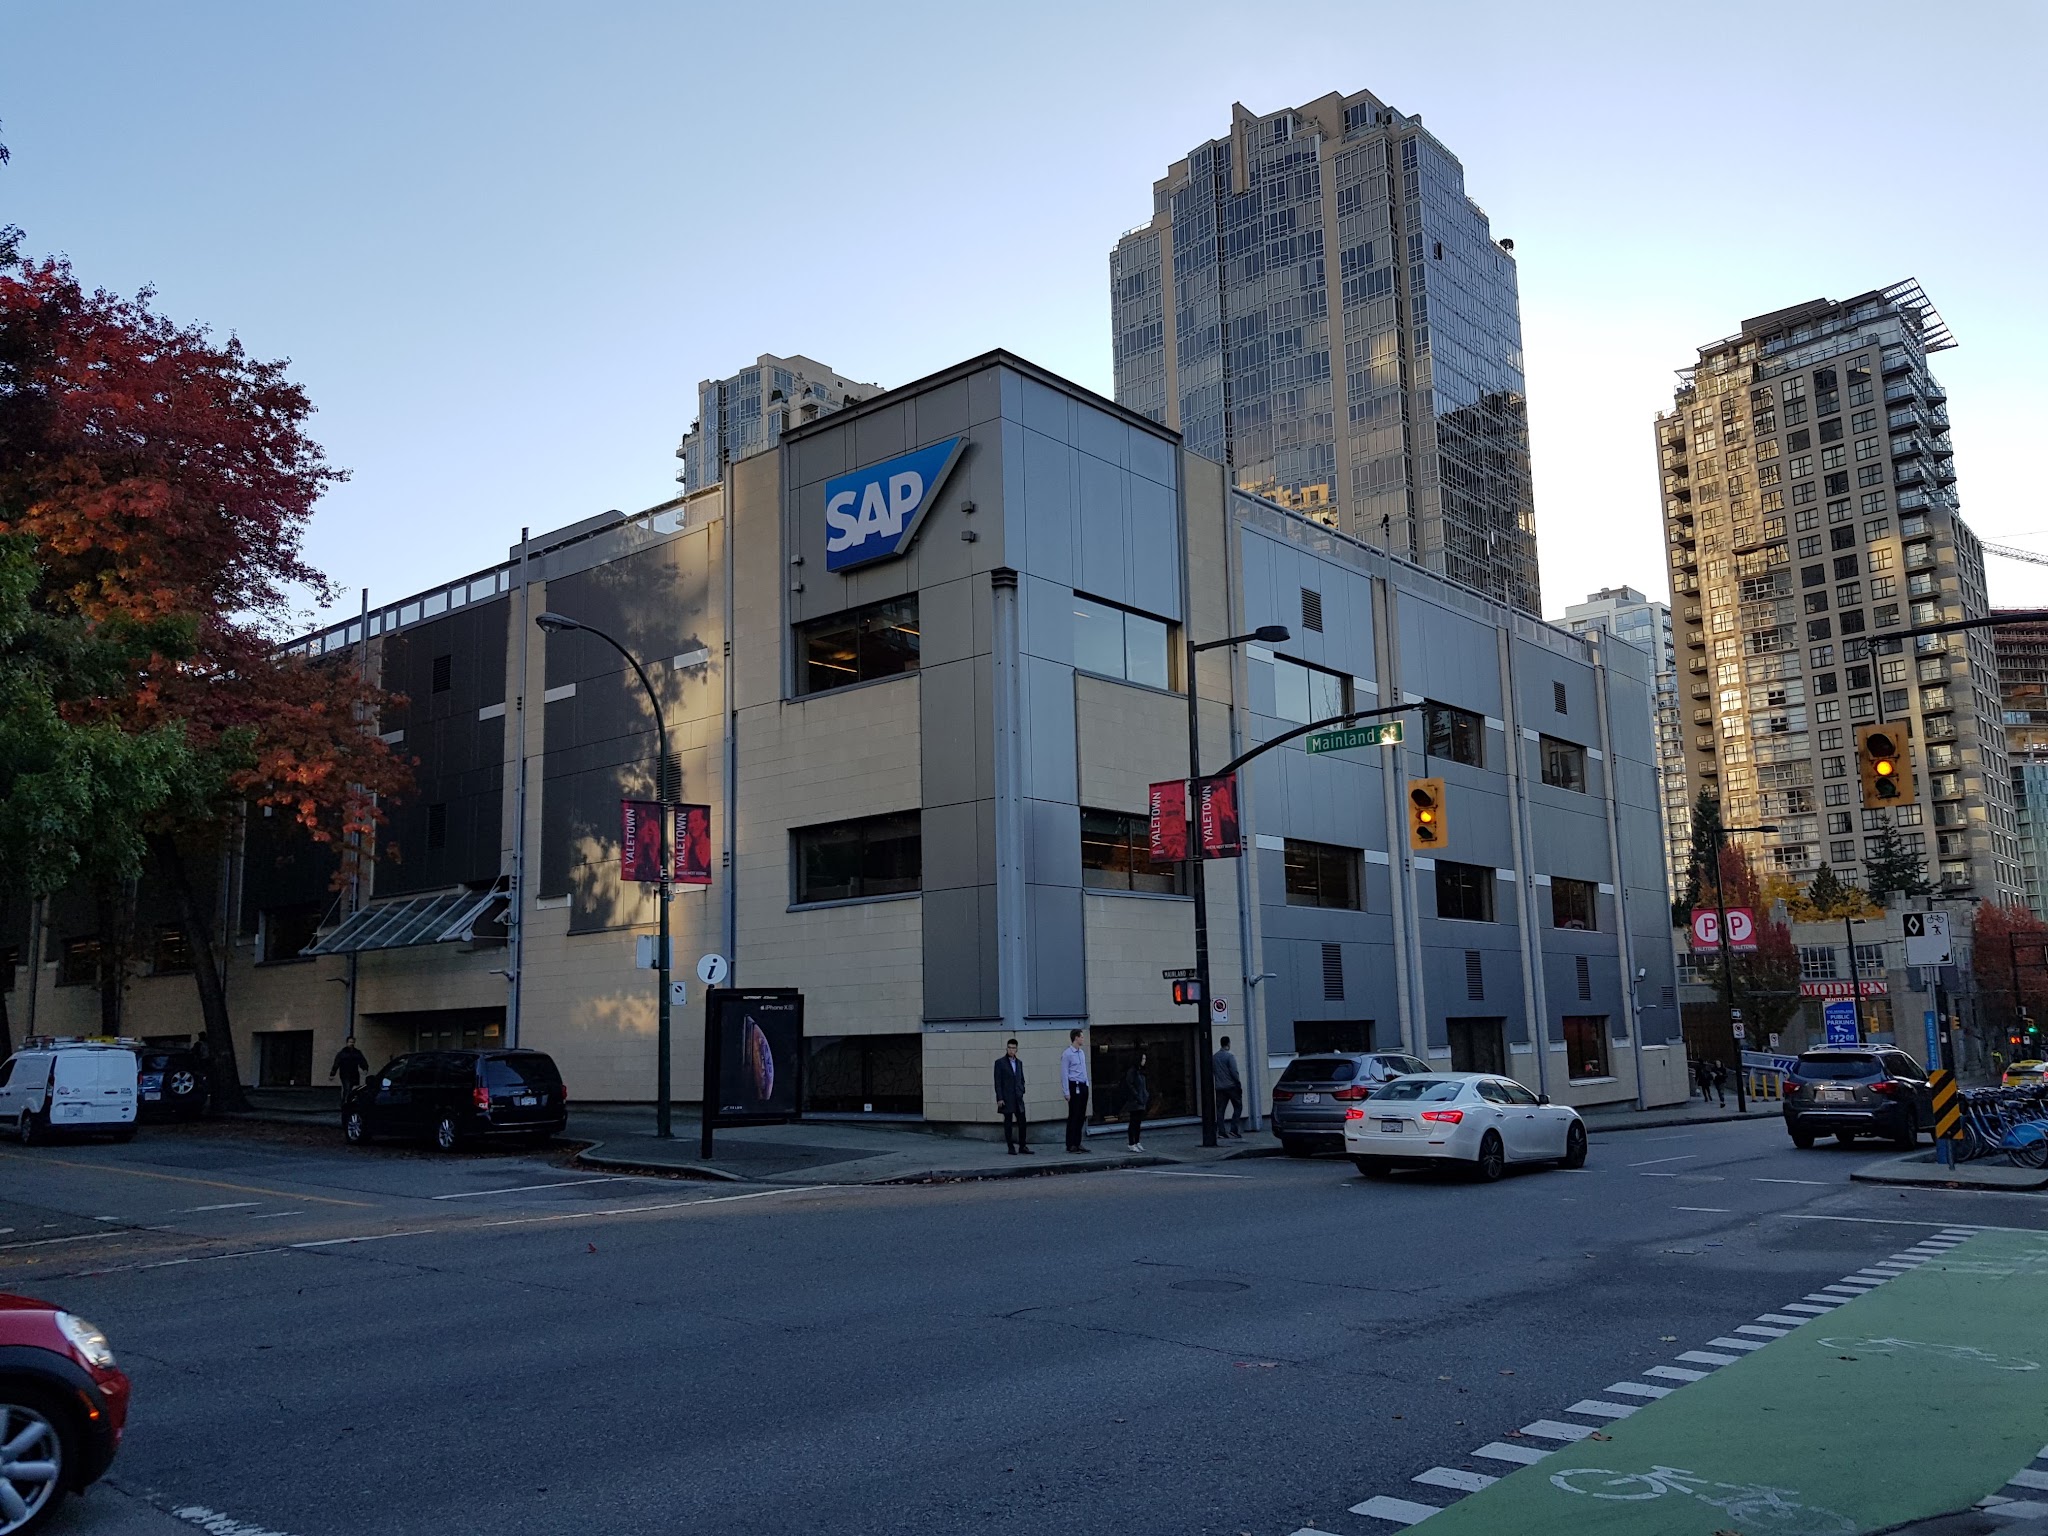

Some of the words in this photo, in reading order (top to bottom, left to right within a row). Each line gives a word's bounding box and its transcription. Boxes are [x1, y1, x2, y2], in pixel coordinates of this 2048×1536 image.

[826, 471, 924, 552] SAP
[1312, 728, 1375, 752] Mainland
[1380, 724, 1397, 743] St
[625, 808, 636, 864] YALETOWN
[676, 812, 687, 868] YALETOWN
[1151, 791, 1162, 848] YALETOWN
[1202, 785, 1214, 843] YALETOWN
[1703, 917, 1716, 937] P
[1730, 916, 1743, 936] P
